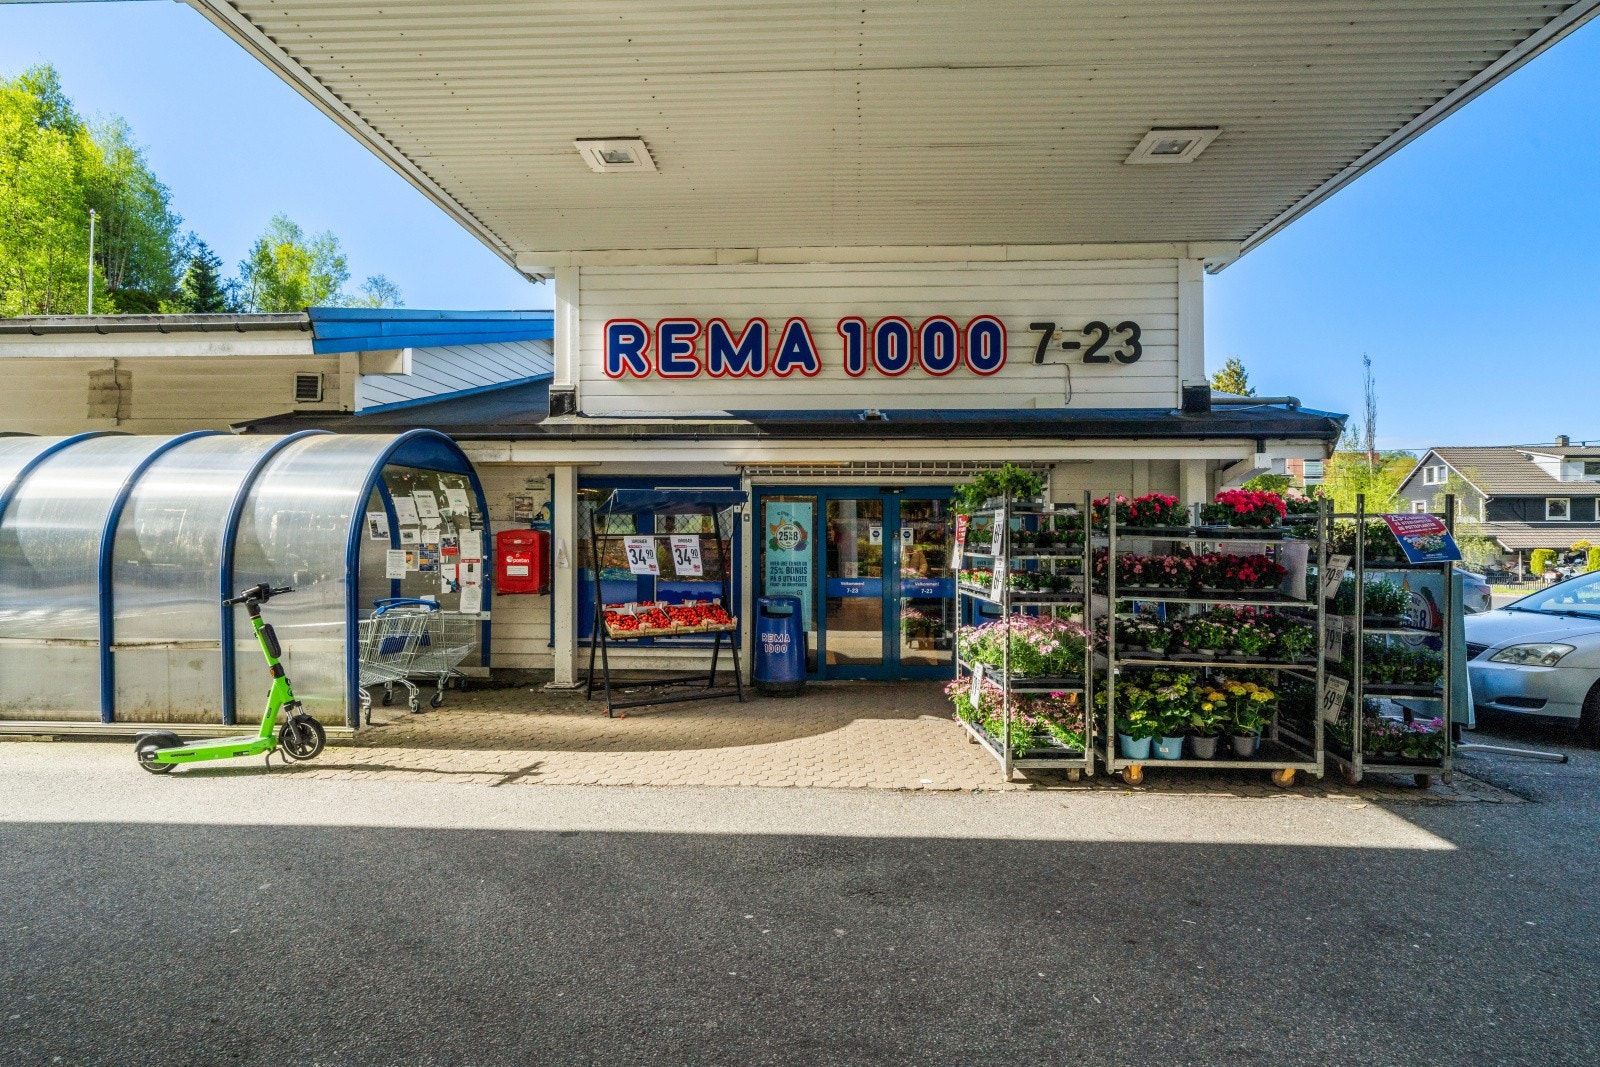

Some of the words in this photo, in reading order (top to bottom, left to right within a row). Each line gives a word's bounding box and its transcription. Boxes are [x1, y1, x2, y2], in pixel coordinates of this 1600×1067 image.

[604, 317, 822, 378] REMA
[837, 315, 1007, 377] 1000
[1028, 321, 1143, 365] 7-23
[778, 531, 789, 541] 25
[793, 531, 798, 541] 8
[629, 548, 647, 565] 34
[645, 549, 654, 558] 90
[675, 548, 691, 566] 34
[690, 549, 698, 557] 90
[762, 633, 791, 643] REMA
[764, 643, 788, 653] 1000
